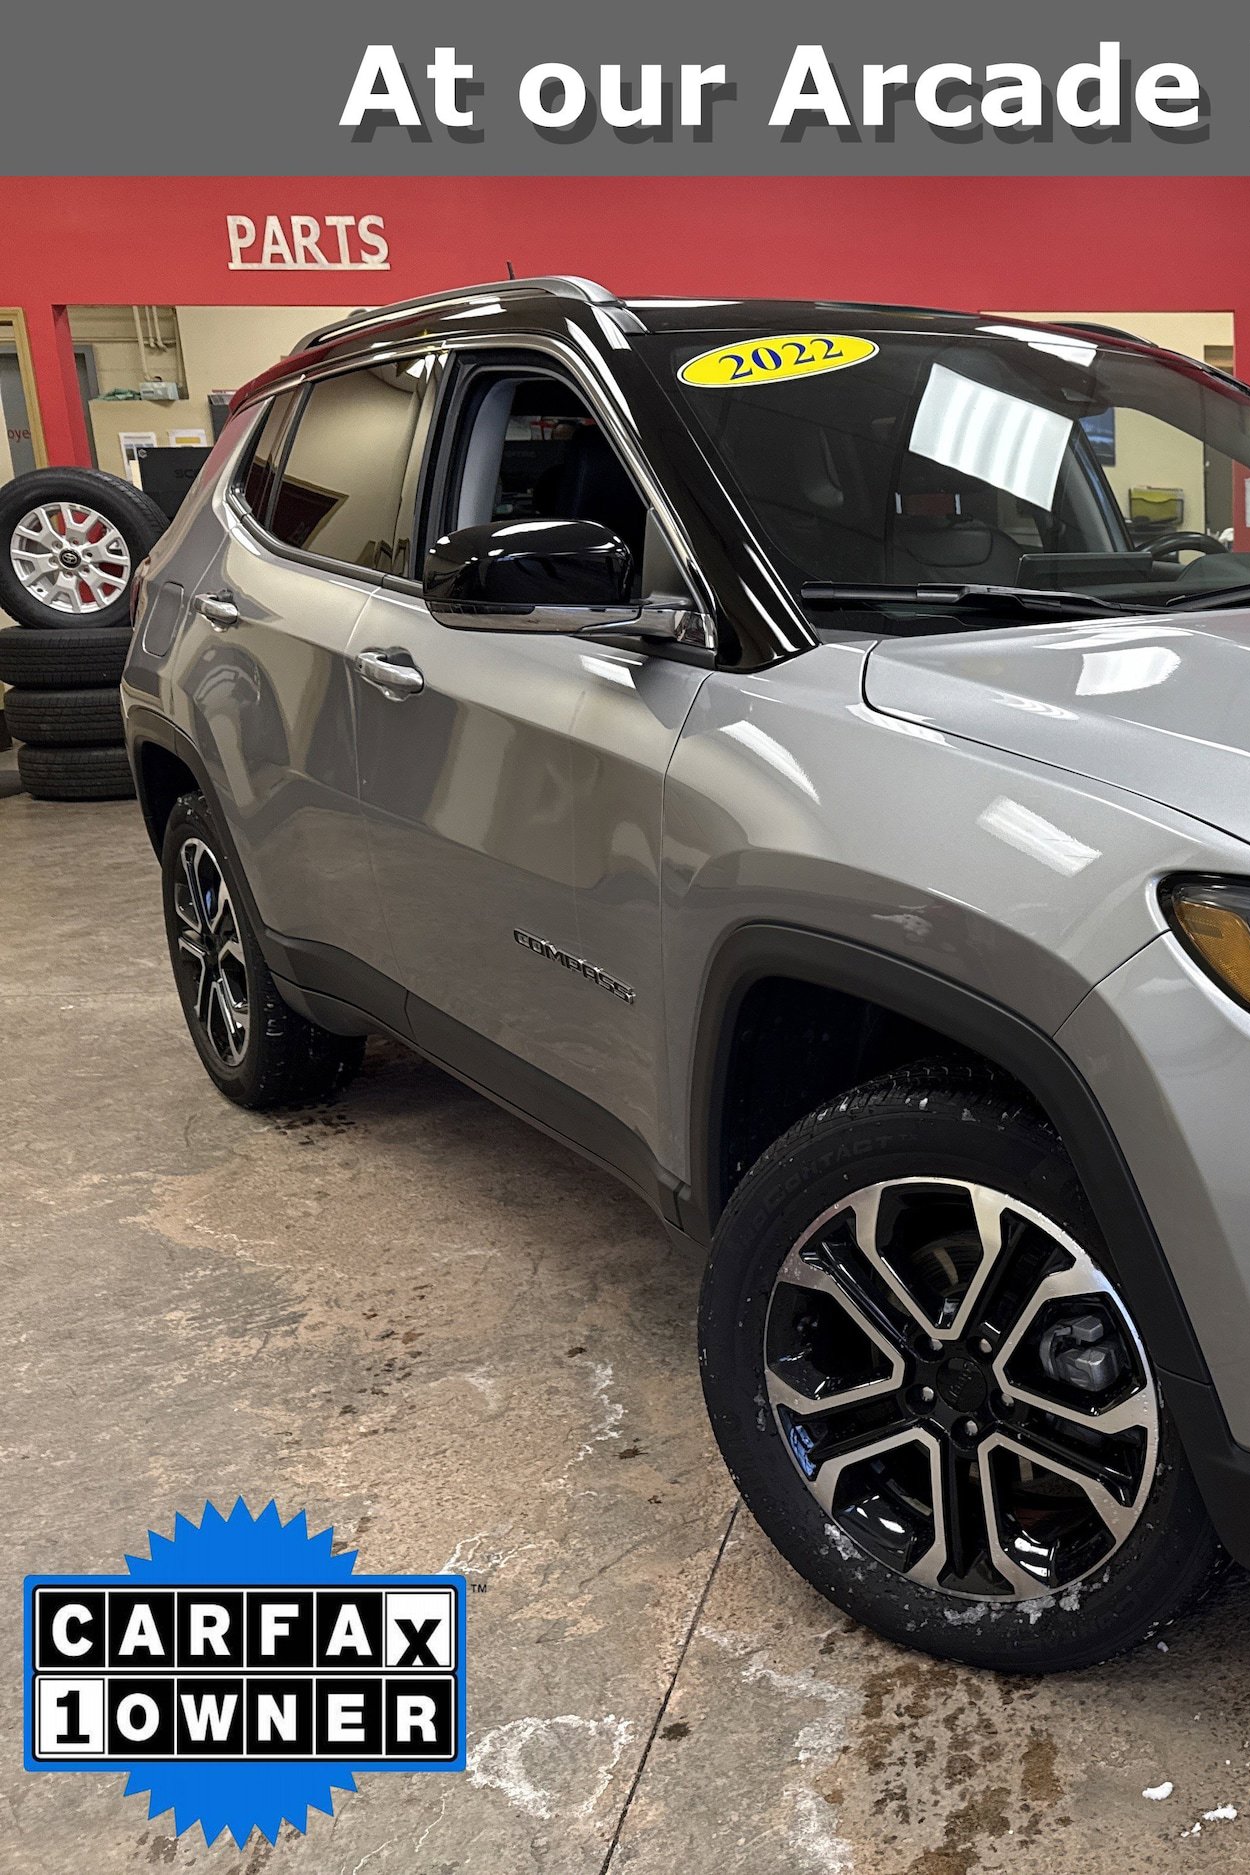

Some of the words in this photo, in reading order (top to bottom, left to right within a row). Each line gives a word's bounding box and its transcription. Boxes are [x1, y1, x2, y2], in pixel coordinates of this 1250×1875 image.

[226, 214, 389, 270] PARTS
[718, 337, 843, 381] 2022
[513, 927, 636, 1004] COMPASS
